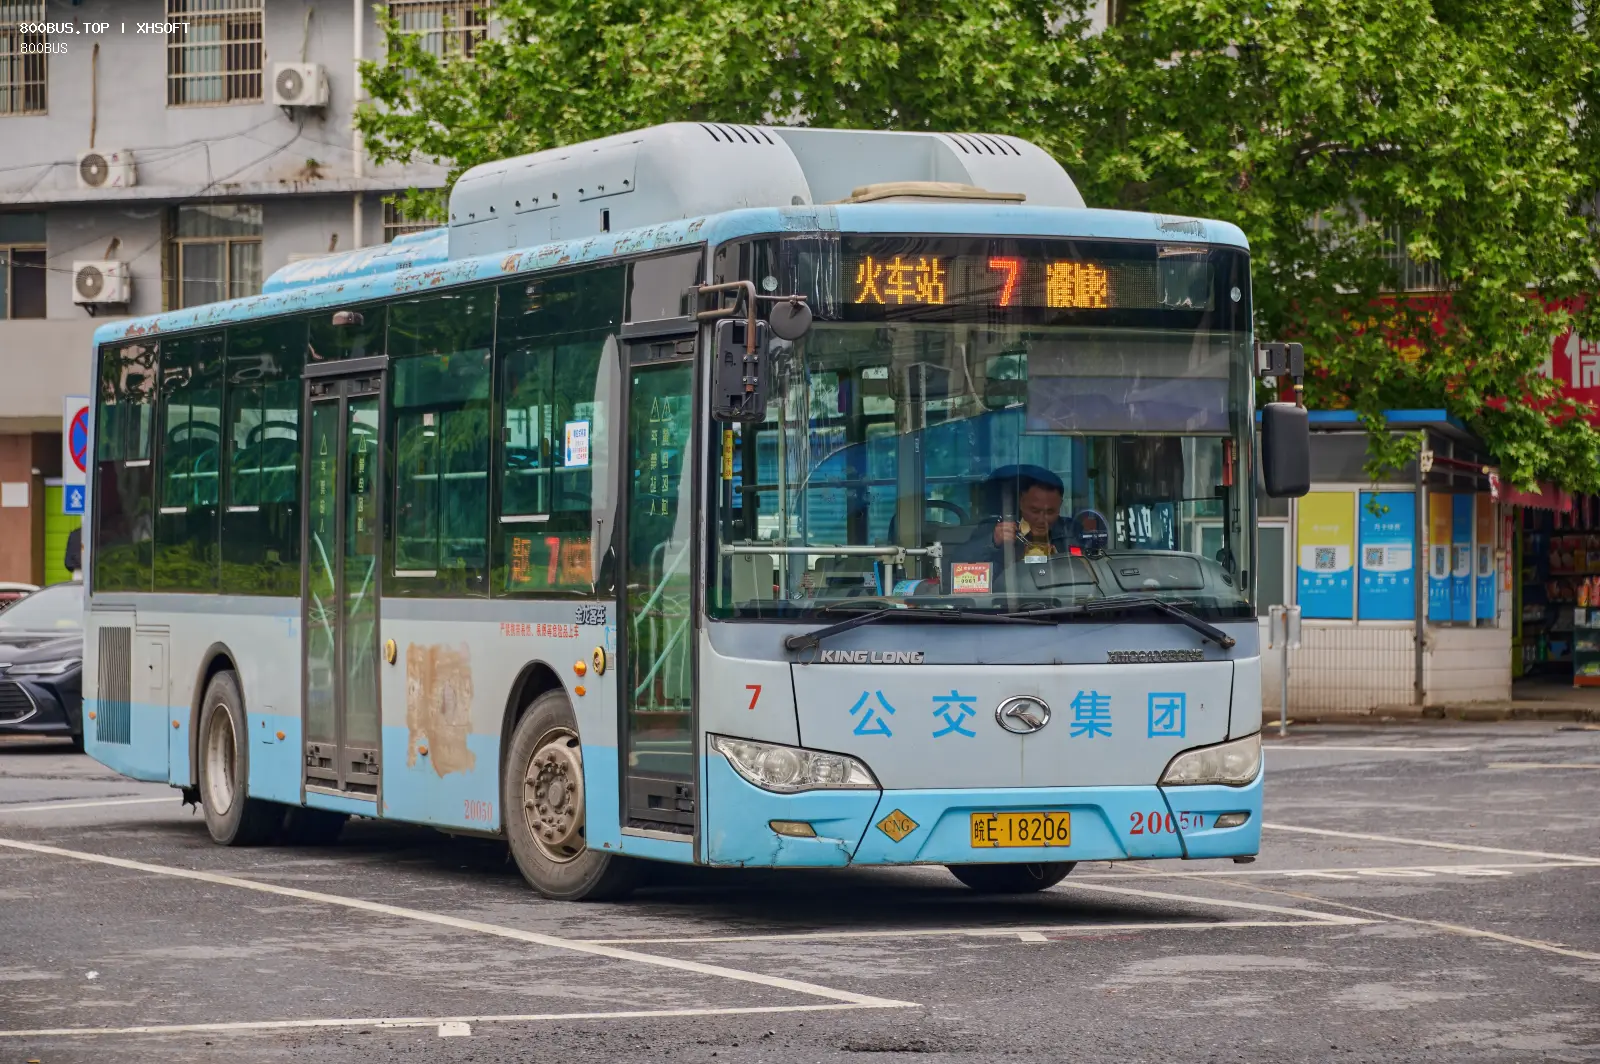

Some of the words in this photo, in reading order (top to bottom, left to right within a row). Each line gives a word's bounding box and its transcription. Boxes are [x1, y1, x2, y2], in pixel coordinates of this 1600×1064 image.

[855, 256, 945, 304] 火车站
[989, 260, 1018, 307] 7
[575, 604, 606, 625] 金龙客车
[820, 650, 869, 663] KING
[870, 651, 925, 664] LONG
[745, 684, 762, 710] 7
[849, 690, 1187, 739] 公交集团
[464, 799, 493, 823] 20050
[884, 819, 910, 834] CNG
